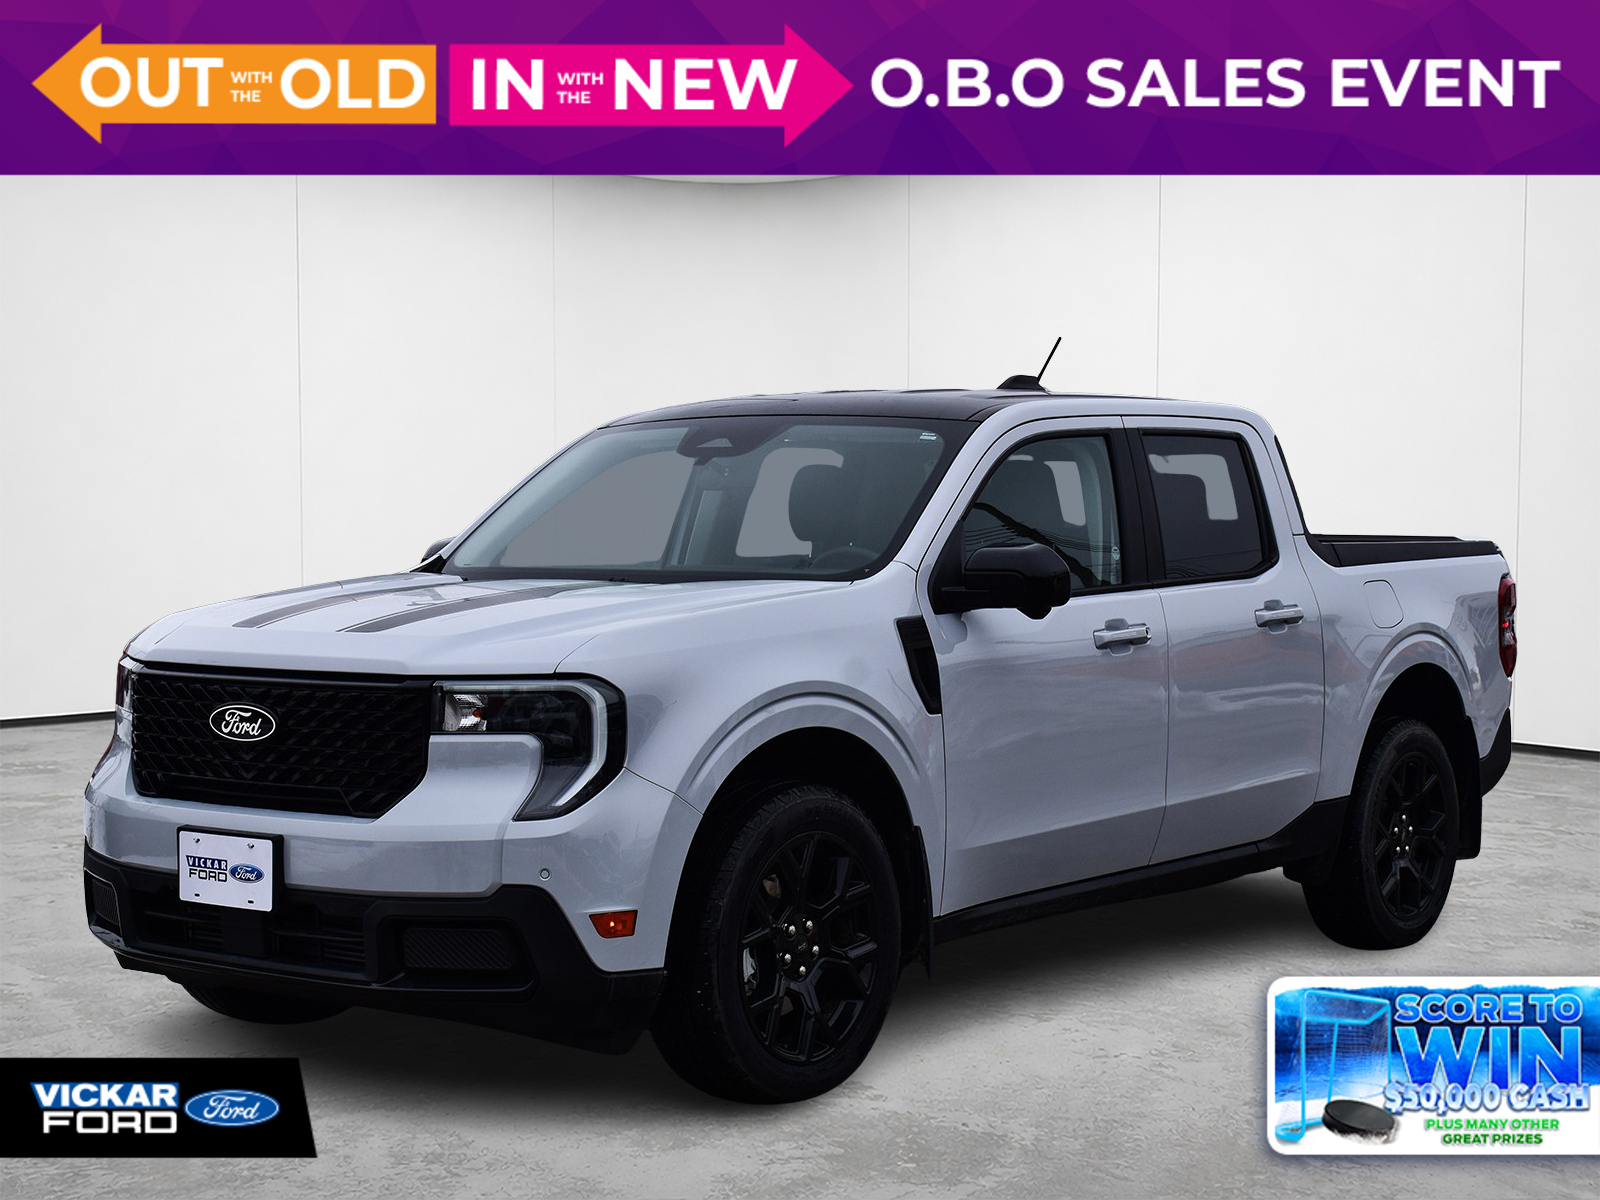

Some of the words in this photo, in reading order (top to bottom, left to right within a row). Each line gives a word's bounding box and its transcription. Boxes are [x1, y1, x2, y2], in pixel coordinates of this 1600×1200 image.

[221, 709, 262, 736] Ford
[188, 857, 227, 870] VICKAR
[189, 868, 227, 882] FORD
[235, 866, 257, 880] Ford
